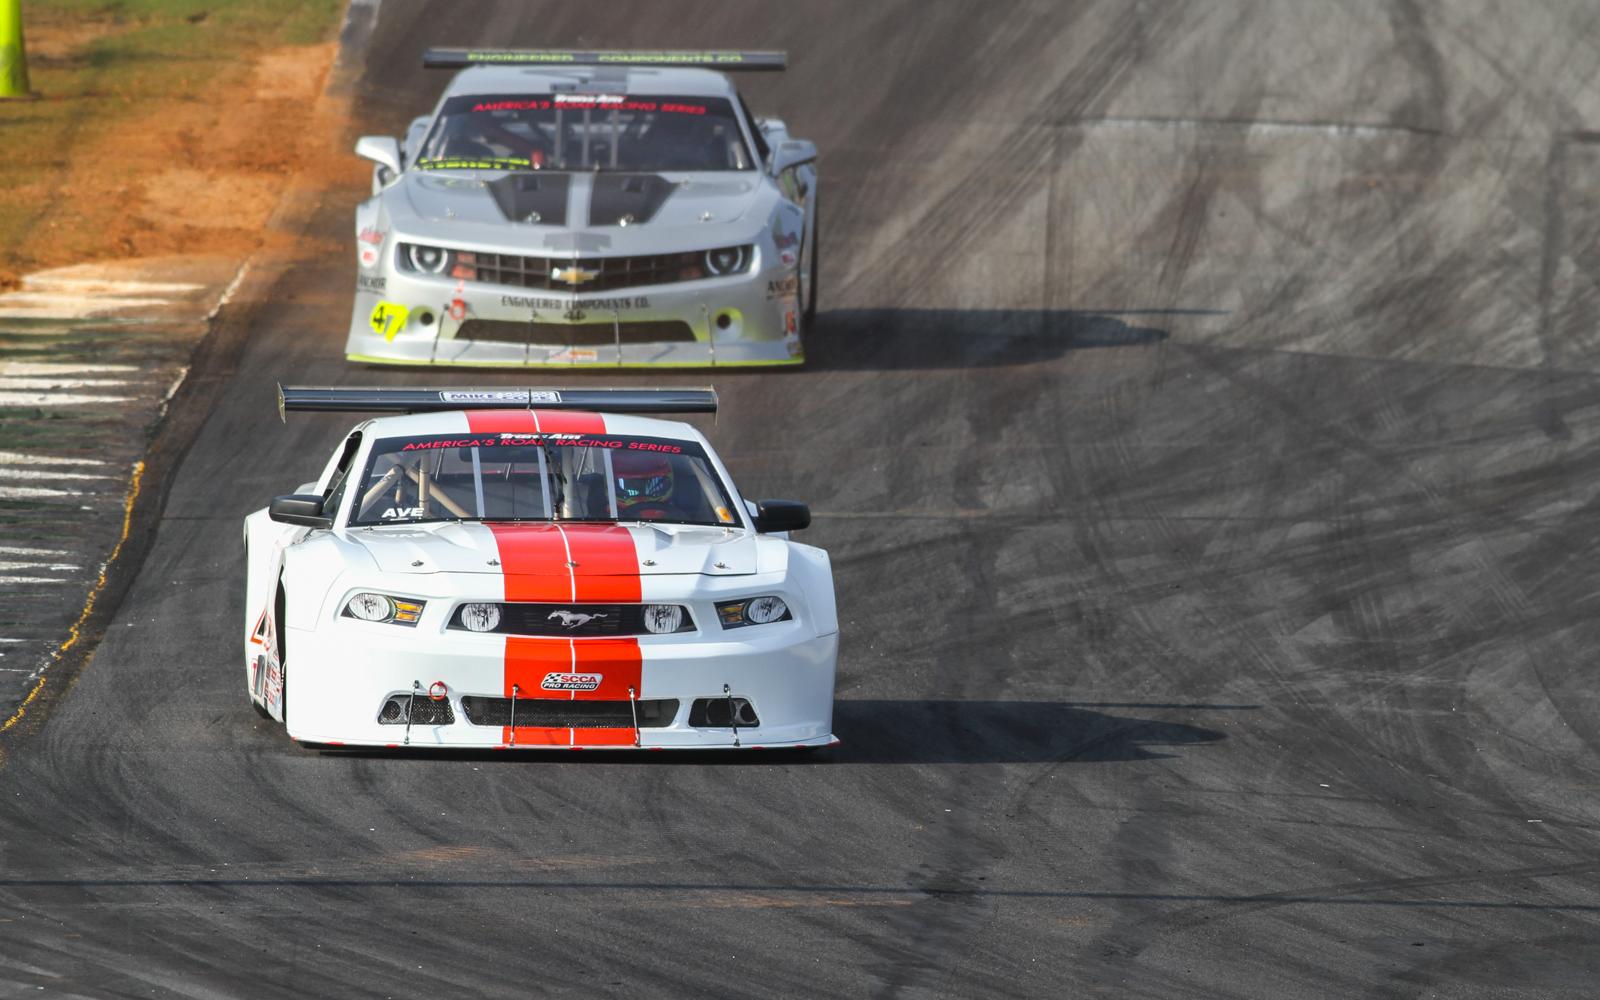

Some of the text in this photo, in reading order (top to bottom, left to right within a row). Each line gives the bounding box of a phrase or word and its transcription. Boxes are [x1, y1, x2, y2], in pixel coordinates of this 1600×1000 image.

[472, 100, 705, 115] AMERICA'S ROAD RACING SERIES
[501, 295, 562, 310] ENGINEERED
[566, 296, 632, 310] COMPONENTS
[402, 438, 682, 454] AMERICA'S ROAD RACING SERIES
[381, 507, 425, 519] AVE
[561, 675, 597, 683] SCCA
